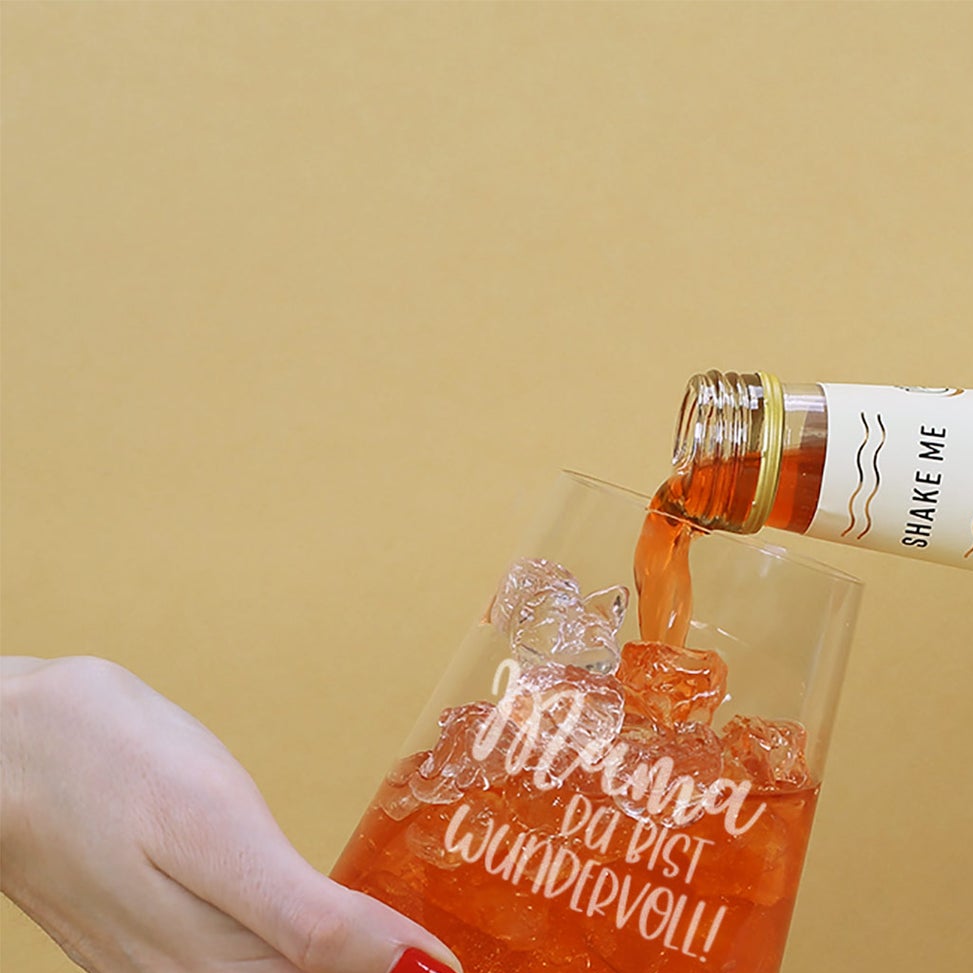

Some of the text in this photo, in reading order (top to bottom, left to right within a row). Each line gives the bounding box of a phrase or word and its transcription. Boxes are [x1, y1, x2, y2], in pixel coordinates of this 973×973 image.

[901, 425, 946, 548] SHAKE ME
[472, 658, 767, 836] Mama
[625, 819, 715, 884] BIST
